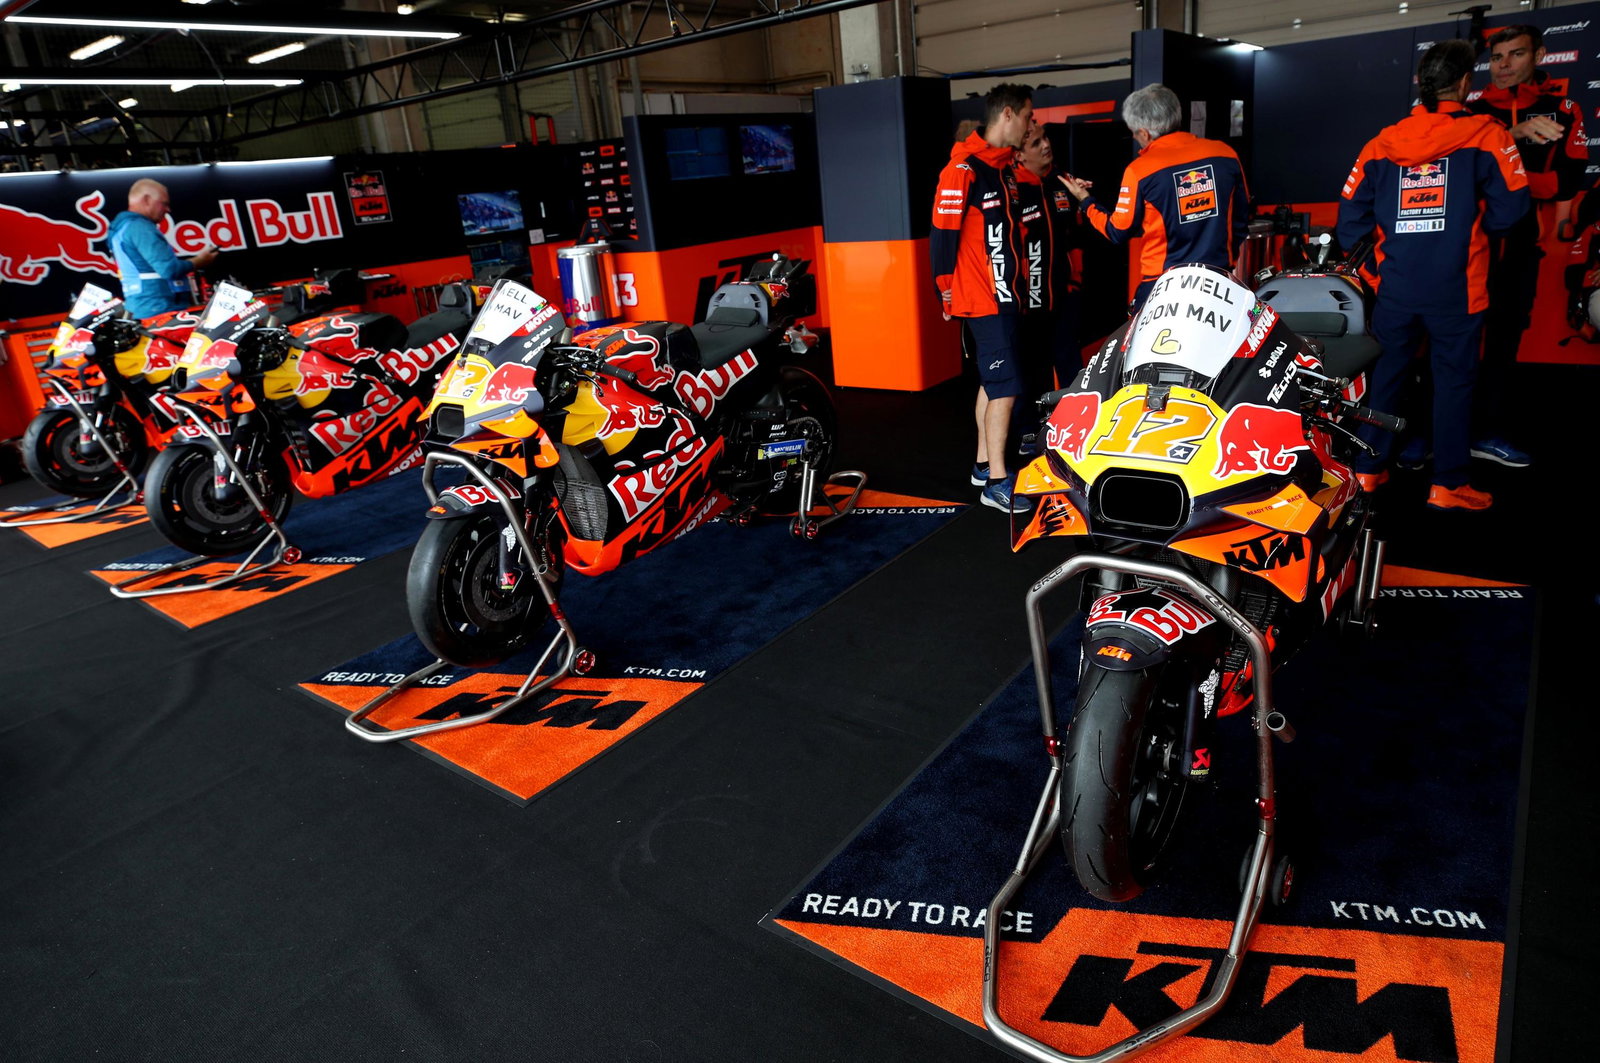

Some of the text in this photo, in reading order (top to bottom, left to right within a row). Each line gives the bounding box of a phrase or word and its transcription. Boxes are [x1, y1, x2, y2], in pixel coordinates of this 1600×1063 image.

[1178, 179, 1214, 198] Red Bull
[1402, 174, 1445, 188] Red Bull
[1185, 197, 1210, 210] KTM
[1408, 192, 1438, 203] KTM
[246, 191, 344, 247] Bull
[1397, 222, 1430, 231] Mobil
[612, 272, 638, 307] 3
[1180, 275, 1233, 305] WELL
[526, 305, 558, 333] MOTUL
[1186, 303, 1231, 333] MAV
[1246, 304, 1276, 352] MOTUL
[375, 333, 460, 386] Bull
[605, 339, 627, 357] KTM
[1266, 341, 1288, 368] BAJAJ
[673, 348, 759, 421] Bull
[1267, 361, 1298, 404] TECH3
[309, 375, 404, 457] Red
[1089, 395, 1218, 464] 12
[388, 445, 424, 476] MOTU
[607, 407, 707, 523] Red
[1247, 507, 1265, 516] READY
[1286, 494, 1303, 504] RACE
[1223, 531, 1306, 572] KTM
[1418, 589, 1448, 598] TO
[1452, 589, 1524, 599] READY
[1126, 587, 1217, 646] Bull
[1097, 645, 1132, 661] KTM
[321, 672, 382, 683] READY
[380, 673, 405, 684] TO
[623, 666, 707, 678] KTM.COM
[413, 686, 649, 731] KTM
[802, 893, 901, 920] READY
[908, 901, 945, 925] TO
[1330, 900, 1487, 930] KTM.COM
[1040, 941, 1459, 1063] KTM
